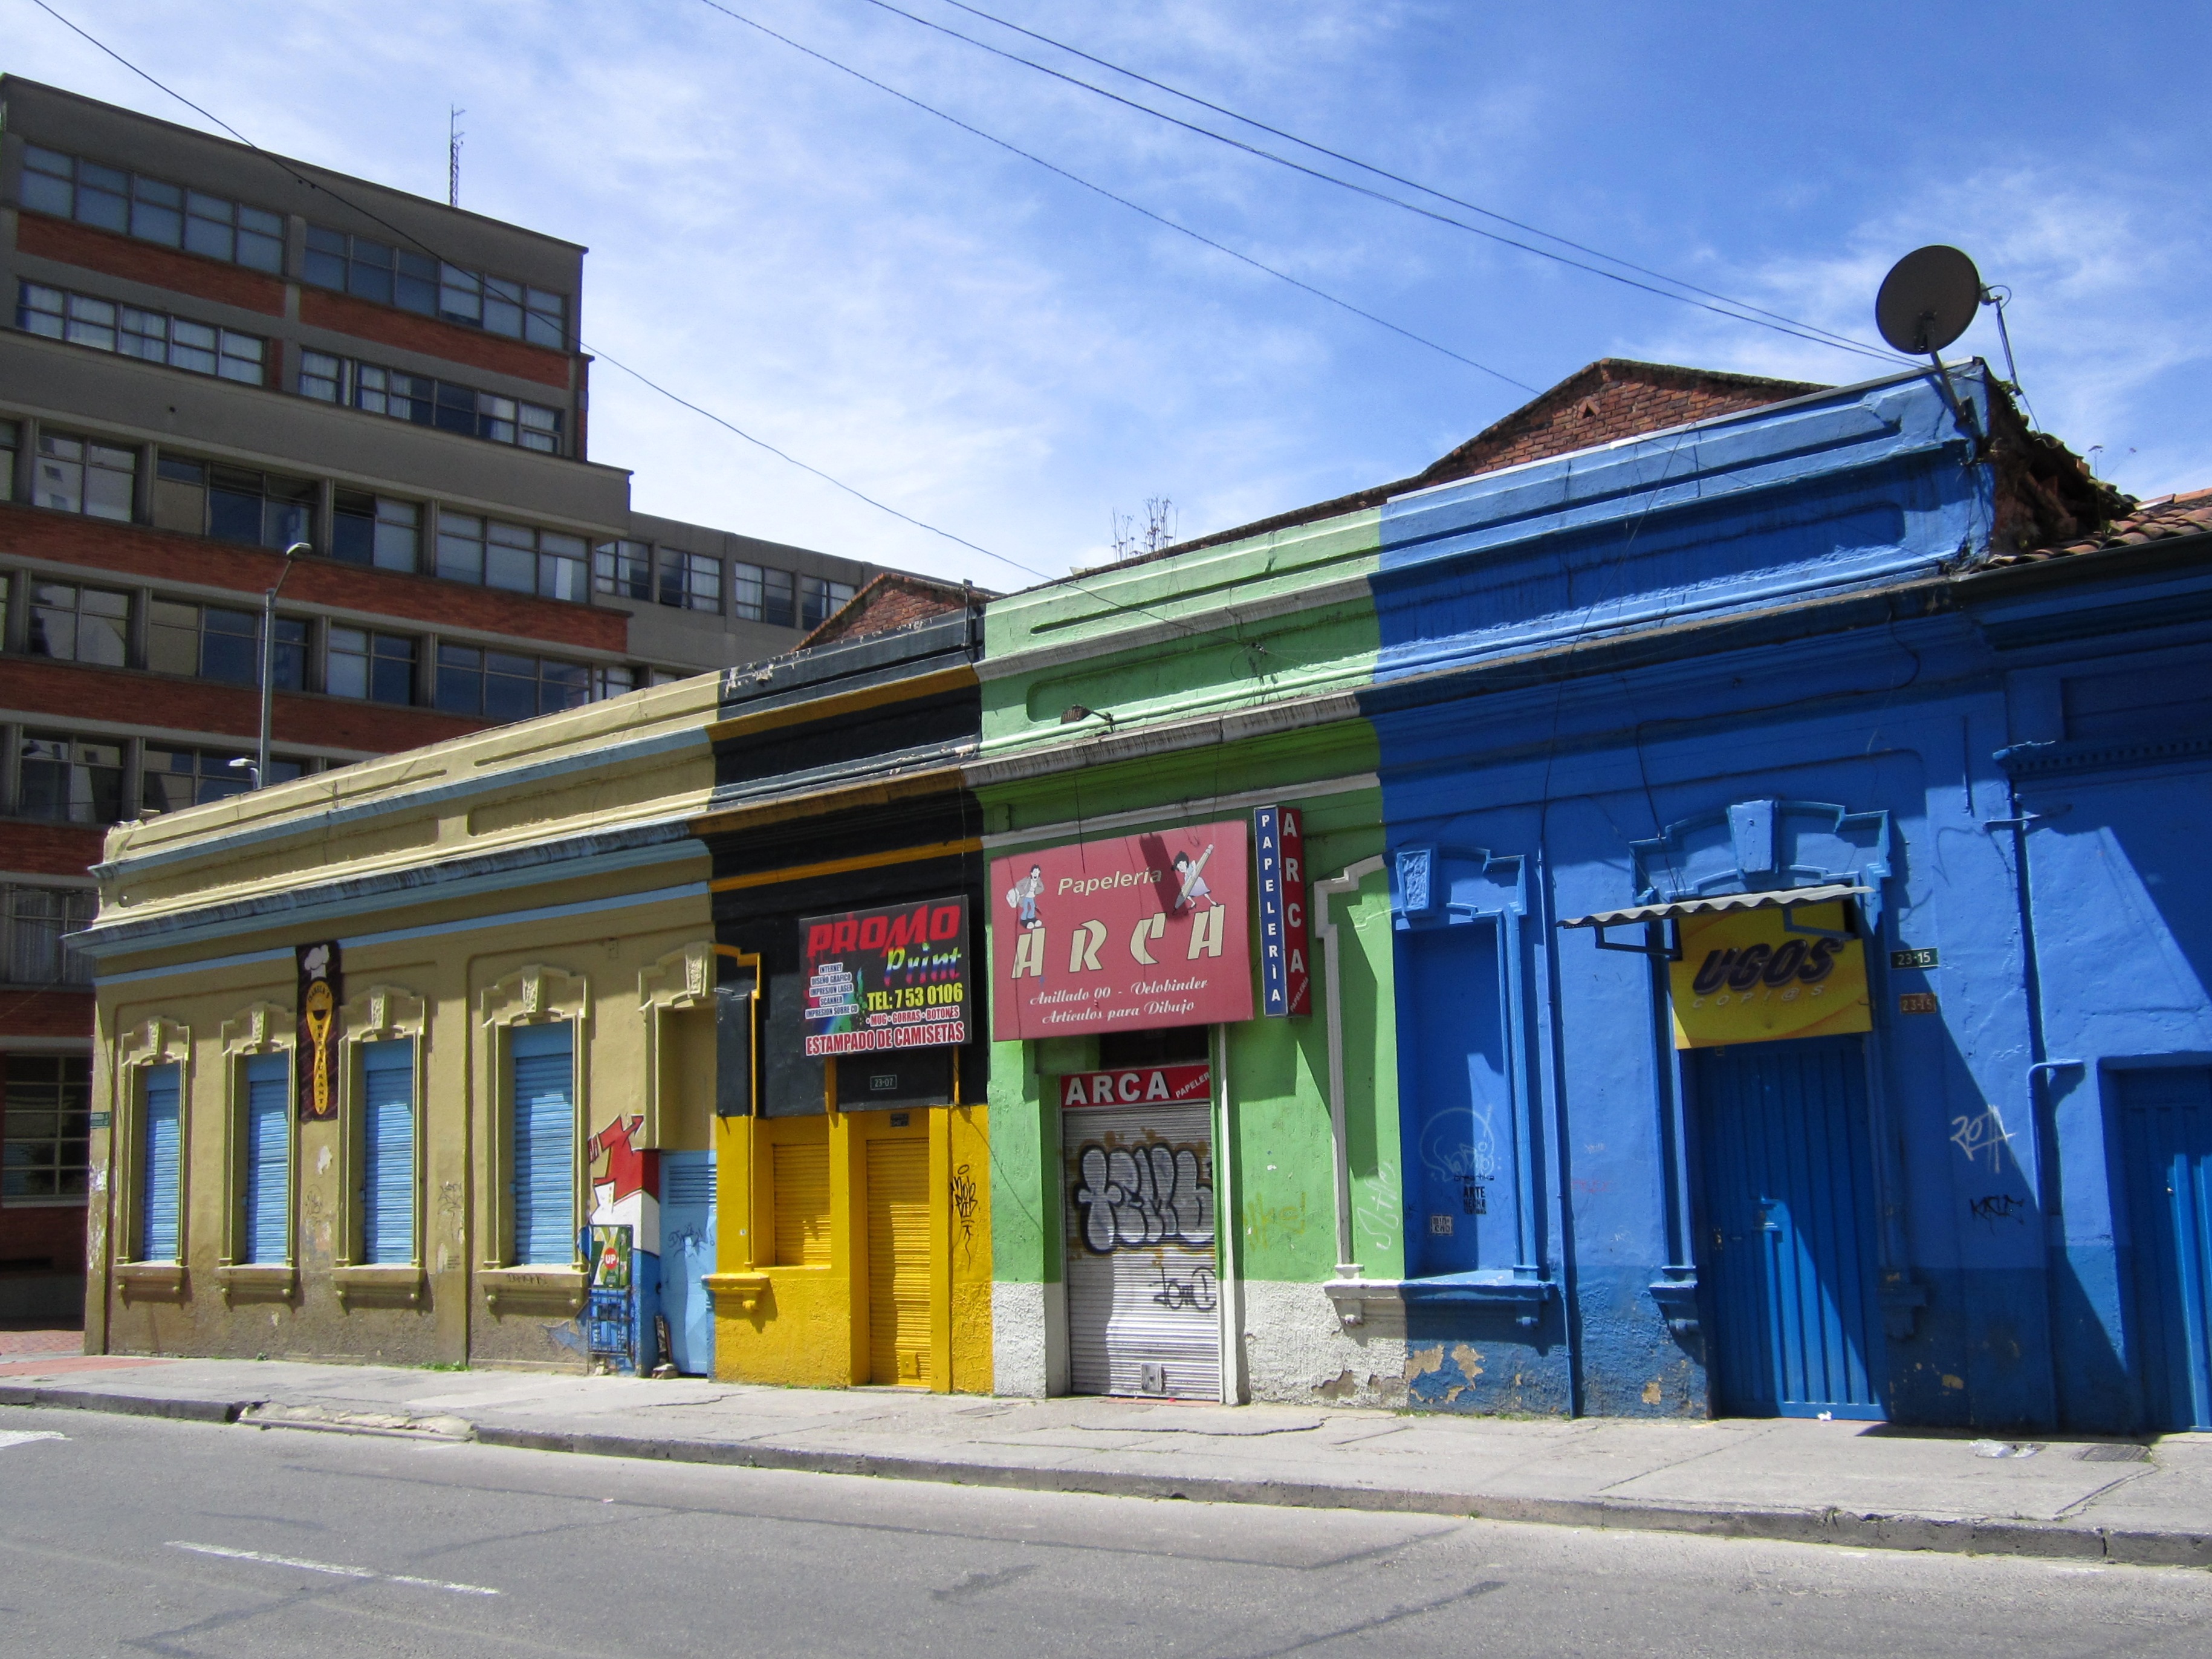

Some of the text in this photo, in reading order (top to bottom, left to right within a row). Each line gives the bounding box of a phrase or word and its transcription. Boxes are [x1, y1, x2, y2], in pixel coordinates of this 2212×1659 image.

[1058, 866, 1162, 896] Papelería
[1283, 813, 1305, 973] ARCA
[806, 904, 961, 958] PROMO
[1011, 904, 1225, 979] ARCA
[819, 964, 842, 973] INTERNET
[884, 942, 962, 986] Print
[1693, 937, 1844, 995] UGOS
[1898, 952, 1931, 965] 23-15
[810, 984, 852, 996] IMPRESION LASER
[830, 973, 851, 984] GRAFICO
[1030, 988, 1089, 1005] Anillado
[1094, 987, 1111, 998] 00
[1130, 976, 1207, 995] Velobinder
[820, 996, 843, 1006] SCANNER
[866, 991, 893, 1011] TEL:
[927, 982, 963, 1005] 0106
[1693, 985, 1824, 1008] COPI@S
[1902, 999, 1932, 1011] 23-15
[806, 1005, 858, 1018] IMPRESION SOBRE CD
[871, 1007, 959, 1025] MUG GORRAS BOTONES
[1042, 999, 1194, 1024] Artículos para Dibujo
[806, 1022, 964, 1054] ESTAMPADO DE CAMISETAS
[875, 1078, 893, 1087] 23-07
[1065, 1071, 1170, 1106] ARCA
[1464, 1186, 1485, 1198] ARTE
